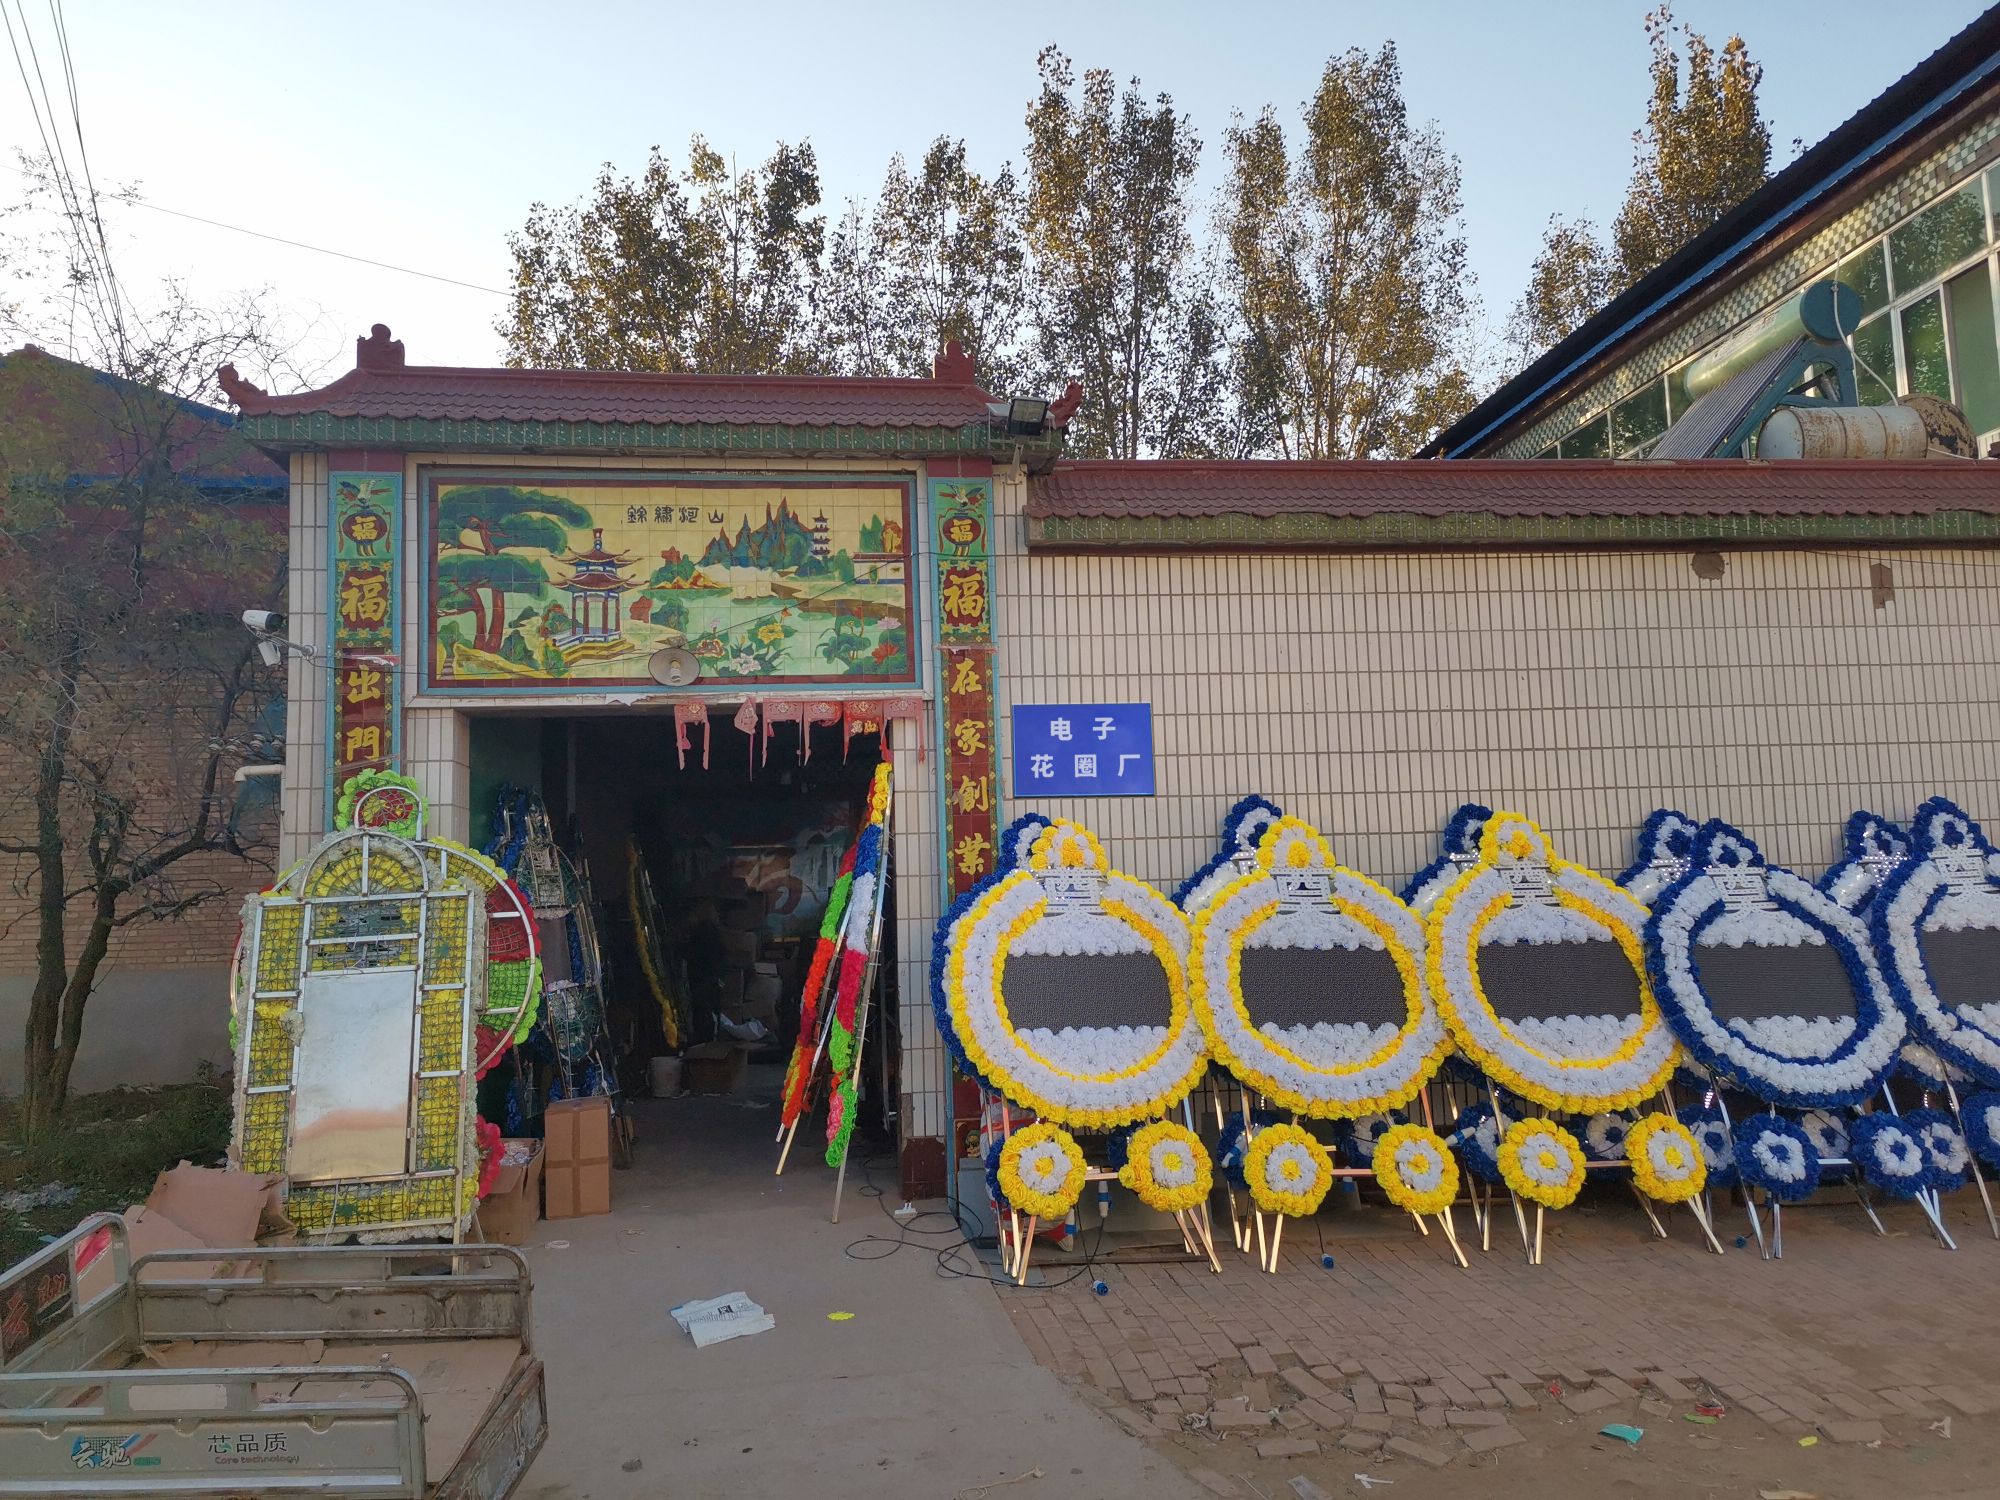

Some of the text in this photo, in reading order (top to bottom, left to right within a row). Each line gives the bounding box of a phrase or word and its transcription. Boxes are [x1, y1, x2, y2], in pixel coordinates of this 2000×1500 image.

[350, 516, 378, 541] 福
[949, 518, 974, 544] 福
[341, 575, 389, 622] 福
[943, 570, 985, 619] 福
[1050, 717, 1117, 742] 电子
[949, 656, 991, 877] 在家創業
[1030, 753, 1141, 779] 花圈厂
[71, 1440, 131, 1469] 云驰
[207, 1432, 288, 1454] 芯品质
[214, 1455, 300, 1465] Core technology
